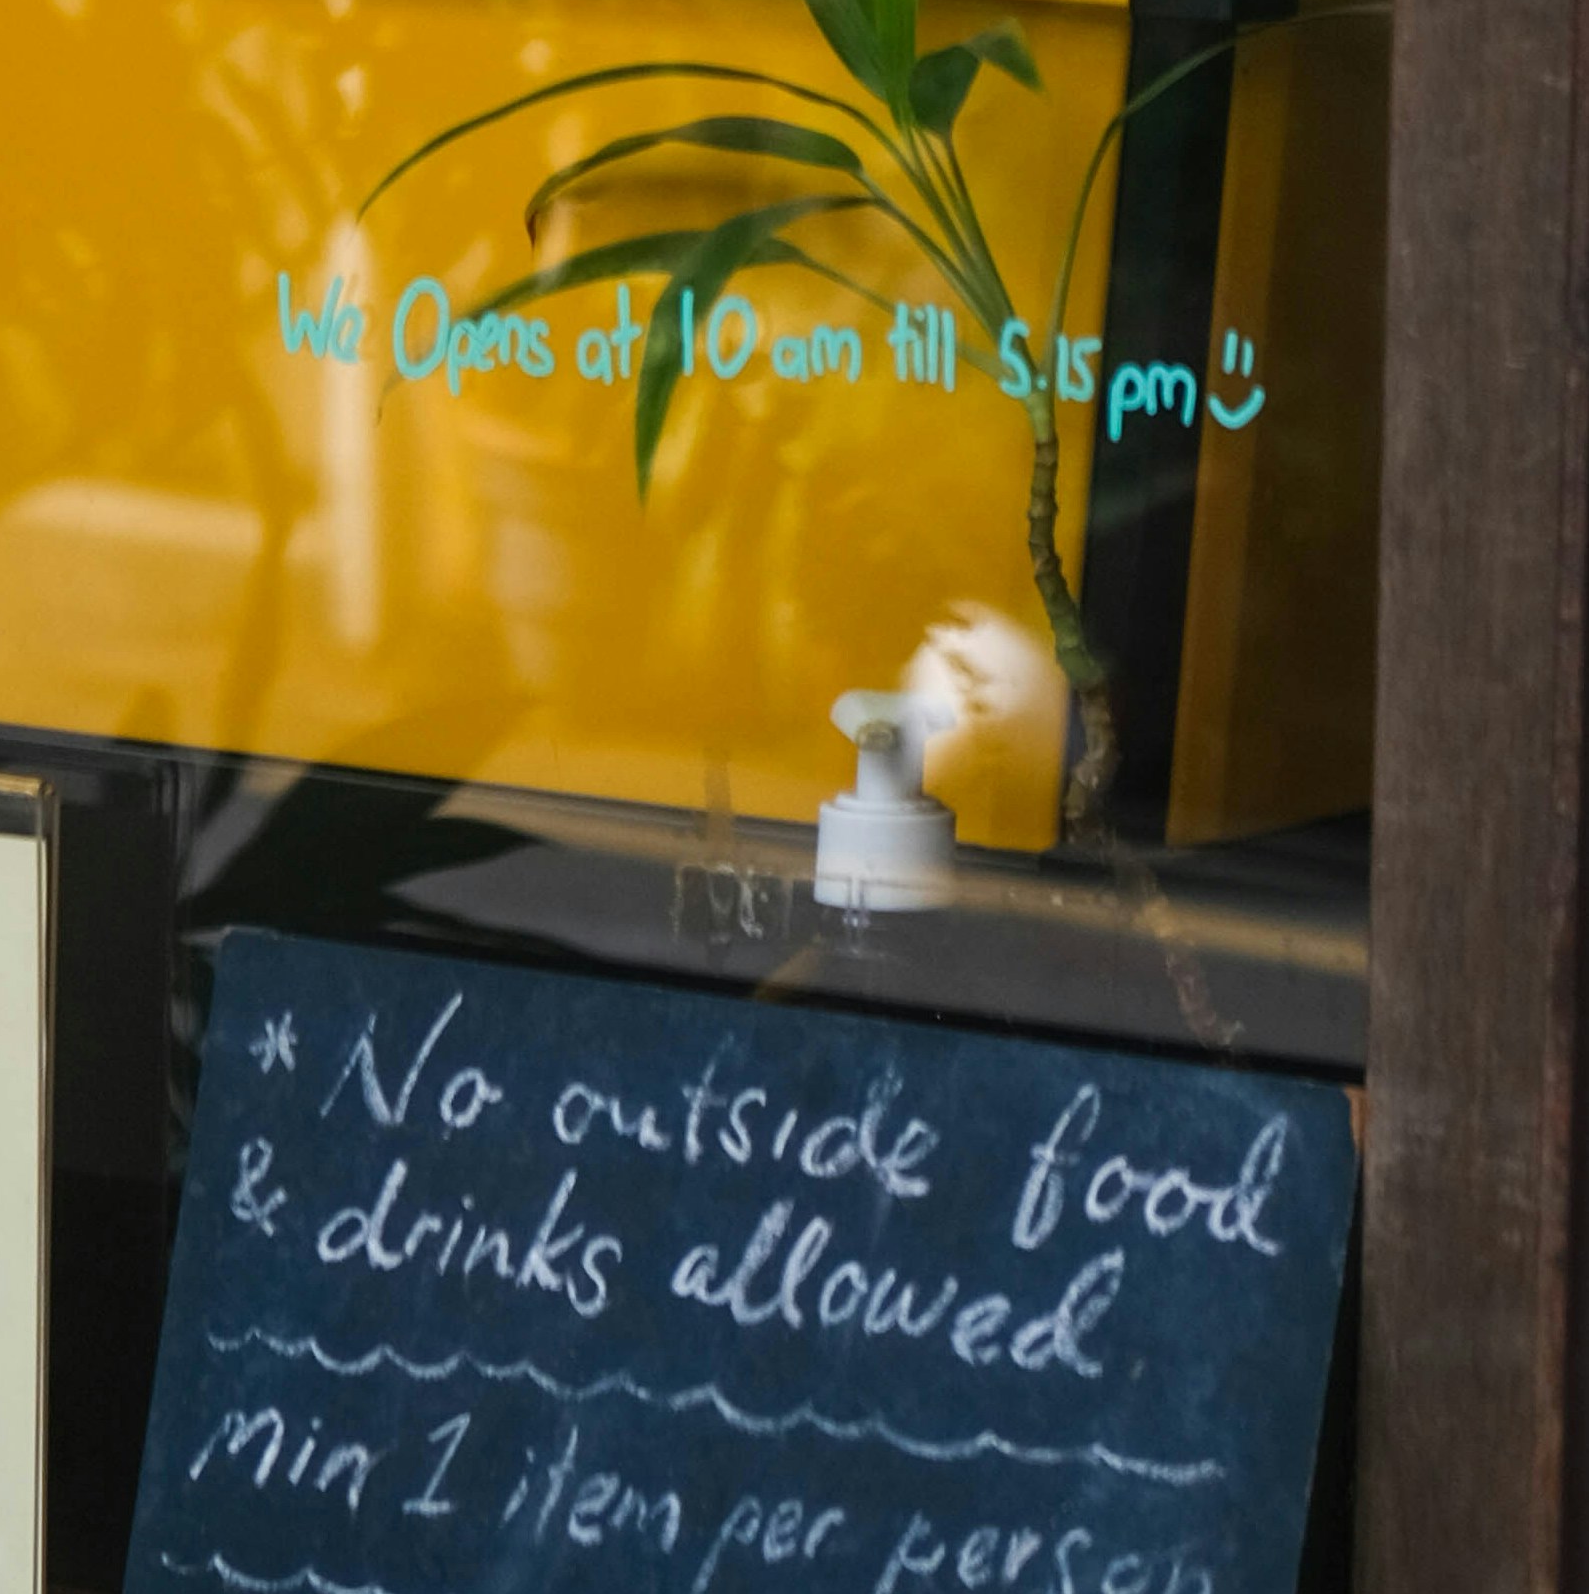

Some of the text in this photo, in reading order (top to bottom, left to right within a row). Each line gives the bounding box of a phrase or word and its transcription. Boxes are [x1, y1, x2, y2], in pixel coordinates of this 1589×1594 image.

[278, 271, 363, 364] We
[393, 276, 554, 396] Opens
[577, 284, 641, 379] at
[772, 325, 861, 381] am
[888, 304, 954, 390] till
[1107, 362, 1195, 441] pm
[319, 991, 1286, 1257] No outside food
[230, 1135, 1124, 1378] & drinks allowed
[500, 1423, 682, 1549] item
[693, 1497, 846, 1594] per
